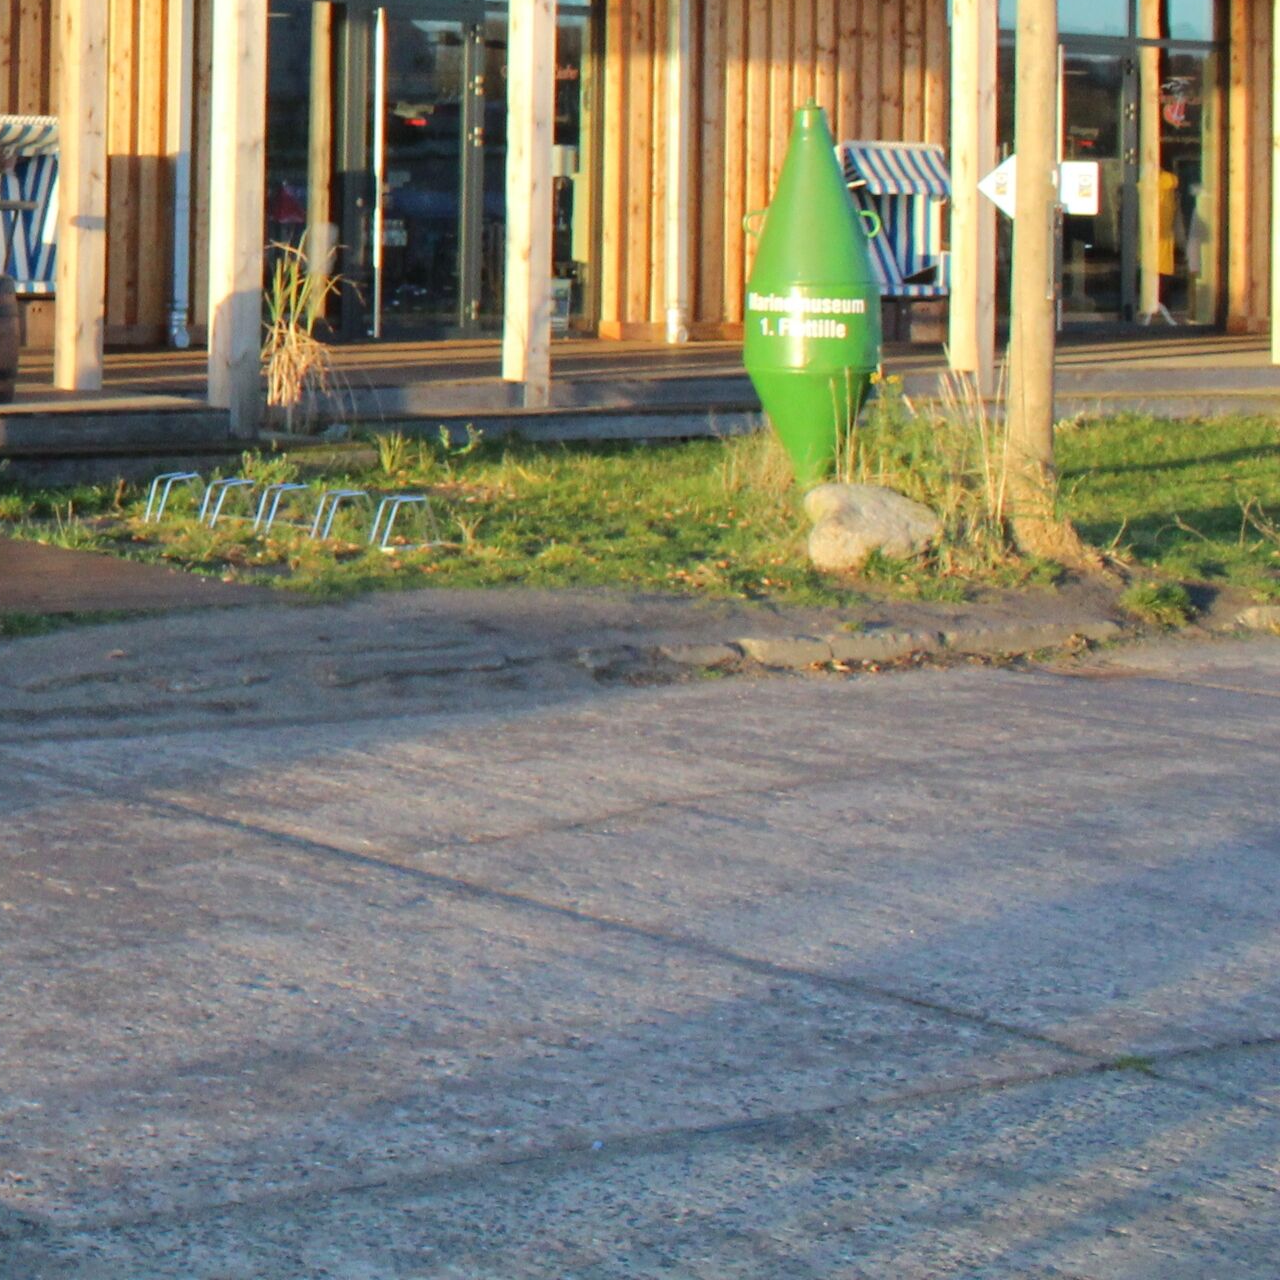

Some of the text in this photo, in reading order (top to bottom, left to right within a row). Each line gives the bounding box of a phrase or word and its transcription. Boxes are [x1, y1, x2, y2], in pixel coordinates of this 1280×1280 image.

[748, 291, 866, 315] Marinmuseum
[760, 317, 847, 339] 1. Fttille
